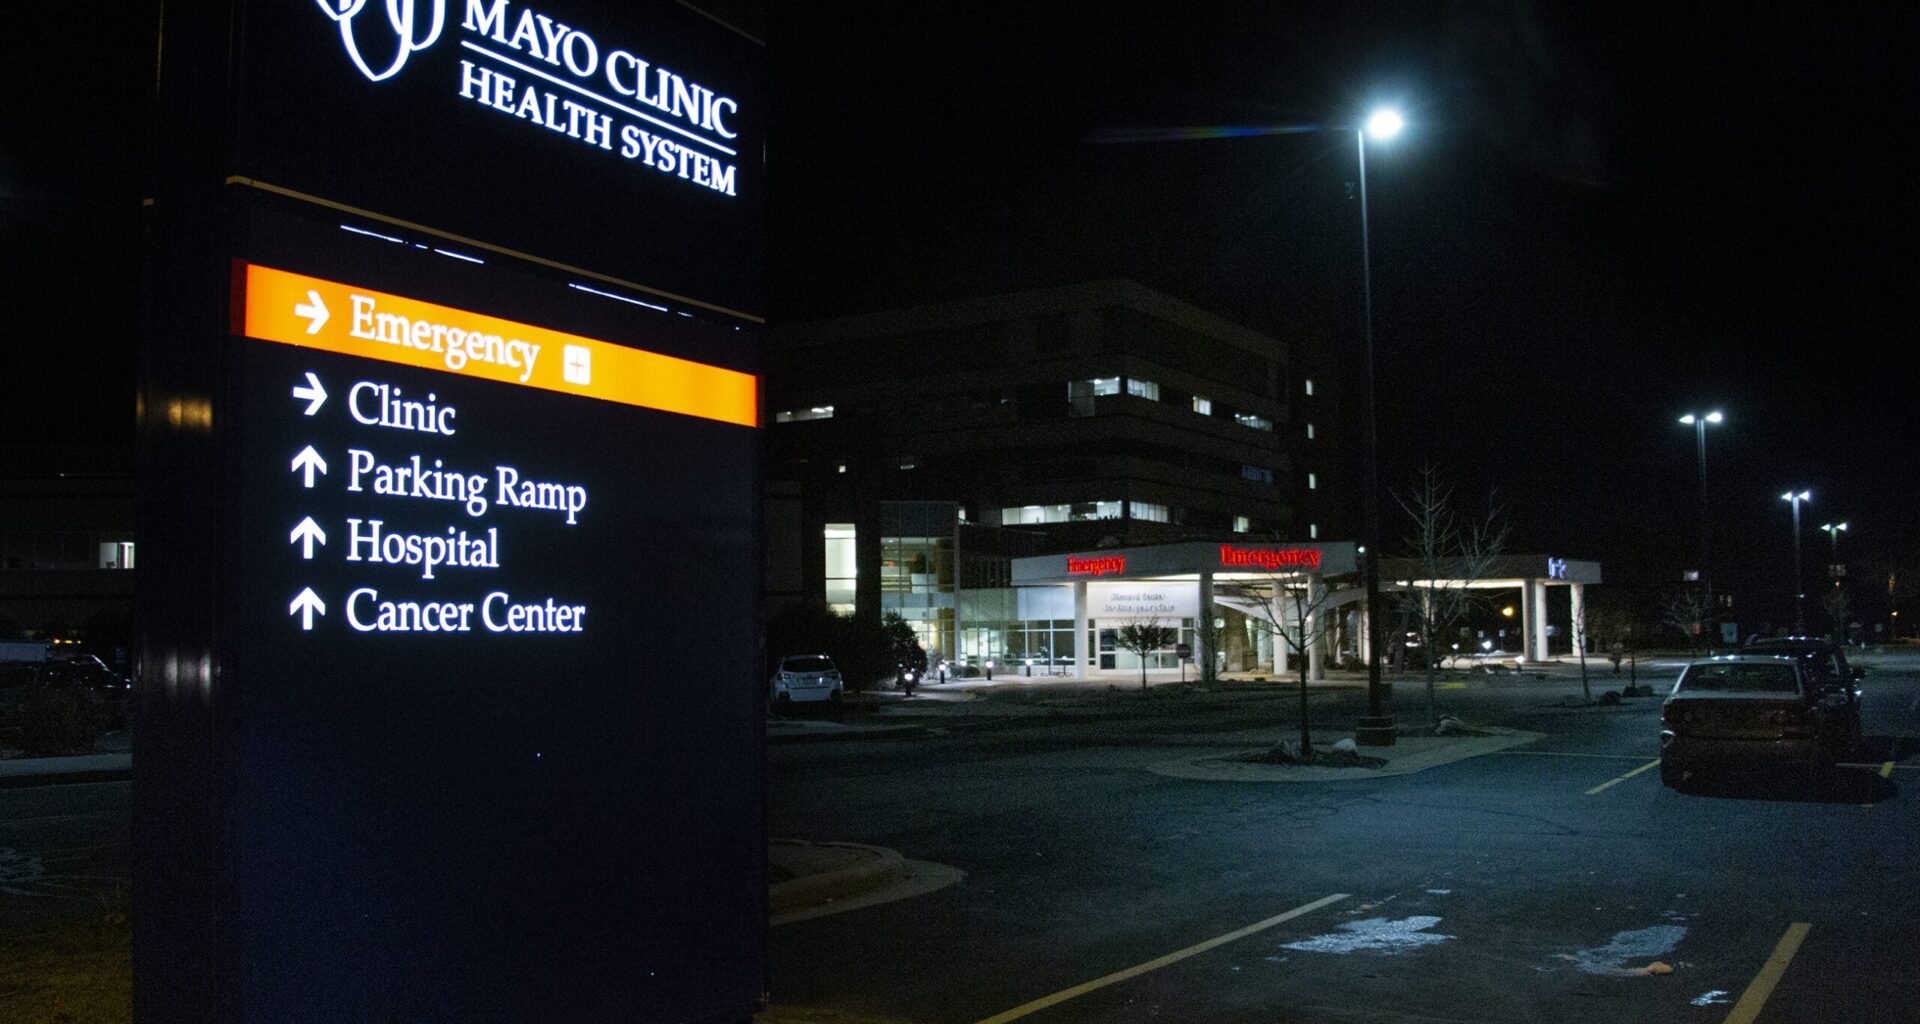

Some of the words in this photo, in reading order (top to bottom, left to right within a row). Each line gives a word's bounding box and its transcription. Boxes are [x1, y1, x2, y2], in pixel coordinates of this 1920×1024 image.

[461, 0, 599, 78] MAYO
[605, 50, 738, 139] CLINIC
[458, 59, 614, 150] HEALTH
[621, 124, 737, 197] SYSTEM
[349, 293, 541, 383] Emergency
[348, 381, 456, 435] Clinic
[347, 448, 488, 517] Parking
[495, 465, 587, 525] Ramp
[346, 518, 500, 580] Hospital
[1067, 554, 1126, 576] Emergency
[1220, 545, 1322, 570] Emergency
[346, 587, 474, 632] Cancer
[481, 591, 586, 633] Center
